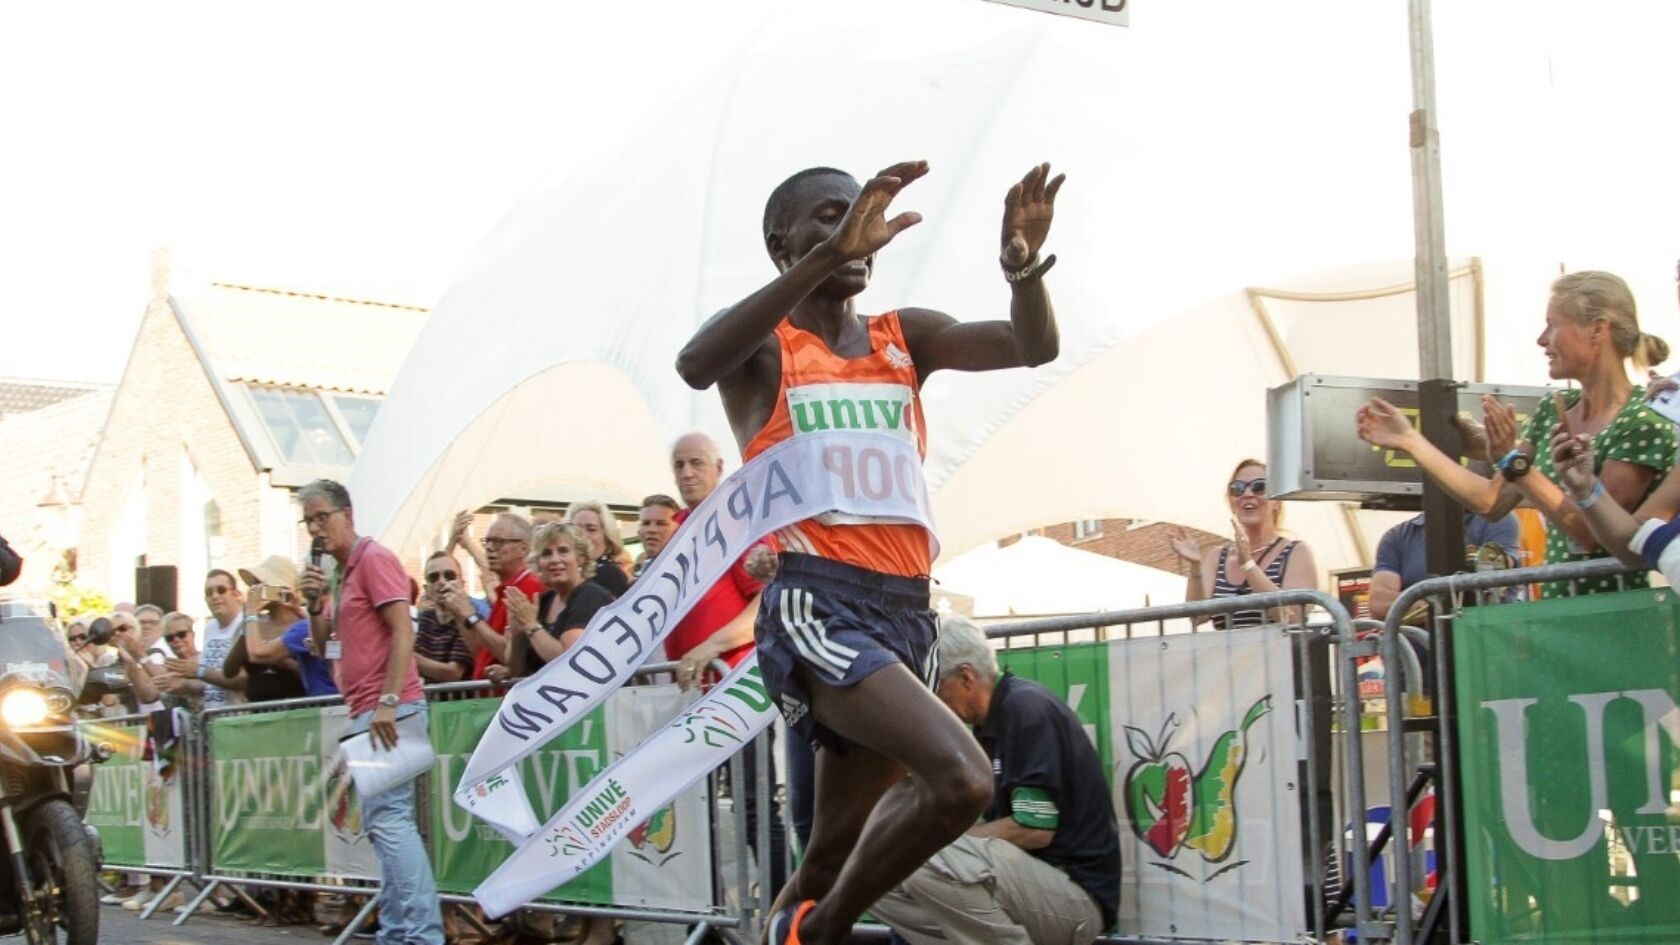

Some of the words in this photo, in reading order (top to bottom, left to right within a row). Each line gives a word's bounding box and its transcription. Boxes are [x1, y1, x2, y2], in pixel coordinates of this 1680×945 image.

[723, 665, 773, 713] U
[214, 731, 321, 832] UNIVÉ
[575, 778, 627, 828] UNIVÉ
[574, 808, 637, 873] APPINGEDAM
[590, 796, 631, 838] STADSLOOP
